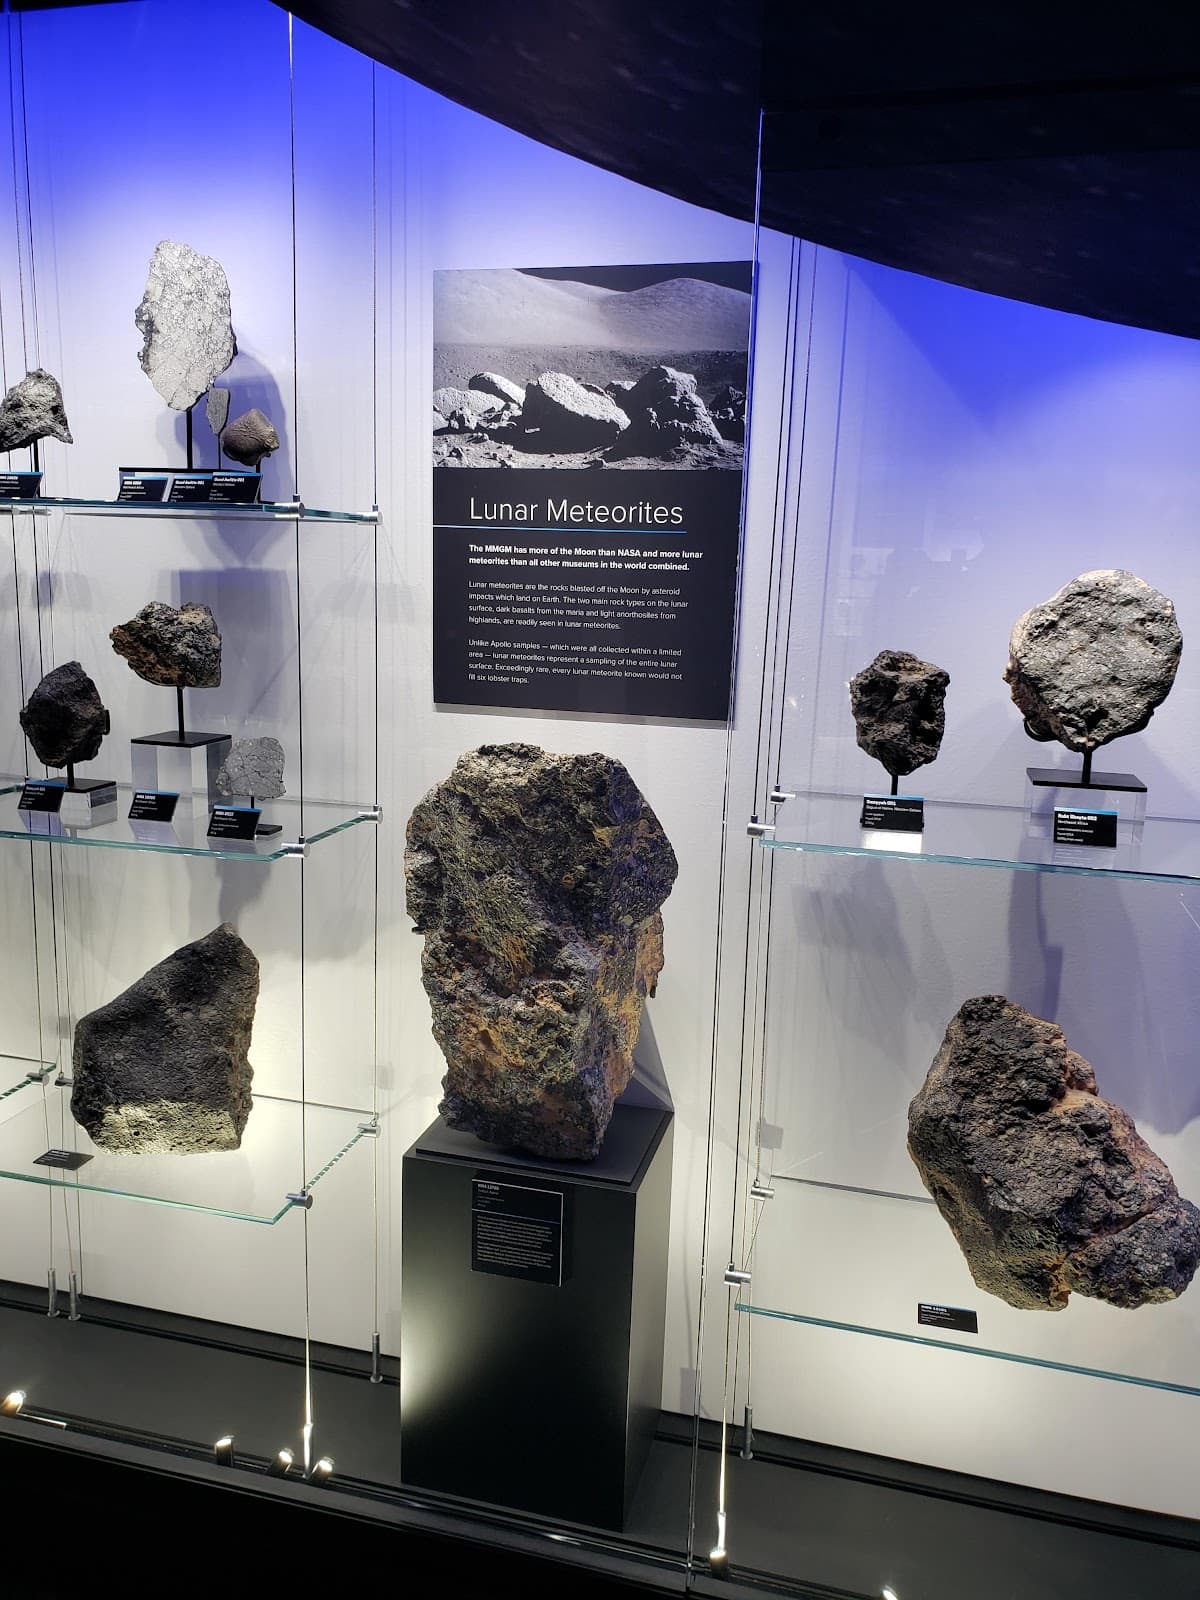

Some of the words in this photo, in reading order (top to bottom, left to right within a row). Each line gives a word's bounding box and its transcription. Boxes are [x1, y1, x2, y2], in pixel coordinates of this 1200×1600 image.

[470, 497, 539, 521] Lunar
[547, 498, 683, 524] Meteorites
[468, 544, 484, 553] The
[484, 544, 513, 553] MMGM
[513, 545, 528, 554] has
[528, 547, 549, 555] more
[549, 546, 559, 555] of
[559, 547, 573, 556] the
[574, 547, 597, 556] Moon
[597, 548, 616, 557] than
[617, 548, 641, 558] NASA
[642, 550, 658, 558] and
[682, 550, 703, 559] lunar
[468, 556, 509, 565] meteorites
[509, 558, 528, 566] than
[528, 558, 539, 566] all
[539, 558, 561, 567] other
[561, 561, 599, 569] museums
[600, 560, 608, 569] in
[609, 560, 623, 569] the
[624, 561, 647, 570] world
[647, 562, 690, 571] combined.
[468, 580, 488, 588] Lunar
[488, 582, 524, 590] meteorites
[537, 583, 549, 591] the
[549, 584, 569, 592] rocks
[569, 584, 595, 593] blasted
[596, 585, 606, 593] off
[606, 585, 619, 594] the
[619, 586, 640, 594] Moon
[641, 587, 651, 596] by
[651, 588, 681, 596] asteroid
[468, 593, 495, 601] impacts
[495, 593, 515, 601] which
[515, 594, 531, 602] land
[542, 595, 562, 604] Earth.
[562, 596, 577, 604] The
[577, 597, 591, 605] two
[609, 598, 625, 606] rock
[626, 599, 646, 608] types
[657, 599, 670, 608] the
[670, 600, 689, 608] lunar
[468, 604, 495, 613] surface,
[495, 605, 511, 613] dark
[511, 606, 536, 614] basalts
[536, 606, 552, 615] from
[553, 607, 565, 616] the
[585, 609, 599, 617] and
[600, 609, 615, 619] light
[616, 611, 659, 619] anorthosites
[660, 611, 676, 620] from
[468, 615, 502, 625] highlands,
[515, 618, 538, 627] readily
[564, 620, 582, 628] lunar
[583, 621, 621, 630] meteorites.
[468, 639, 490, 647] Unlike
[490, 640, 512, 649] Apollo
[512, 642, 541, 650] samples
[549, 643, 570, 651] which
[588, 645, 597, 653] all
[598, 645, 630, 654] collected
[630, 647, 651, 655] within
[658, 648, 682, 656] limited
[492, 652, 509, 660] lunar
[510, 653, 546, 662] meteorites
[546, 655, 579, 663] represent
[585, 657, 617, 667] sampling
[617, 658, 625, 666] of
[626, 658, 638, 666] the
[660, 660, 678, 668] lunar
[468, 662, 494, 670] surface.
[495, 663, 535, 674] Exceedingly
[535, 666, 551, 674] rare,
[551, 667, 571, 676] every
[572, 667, 589, 675] lunar
[590, 669, 623, 677] meteorite
[624, 670, 647, 678] known
[647, 672, 670, 680] would
[468, 673, 476, 681] fill
[487, 674, 510, 683] lobster
[511, 676, 529, 684] traps.
